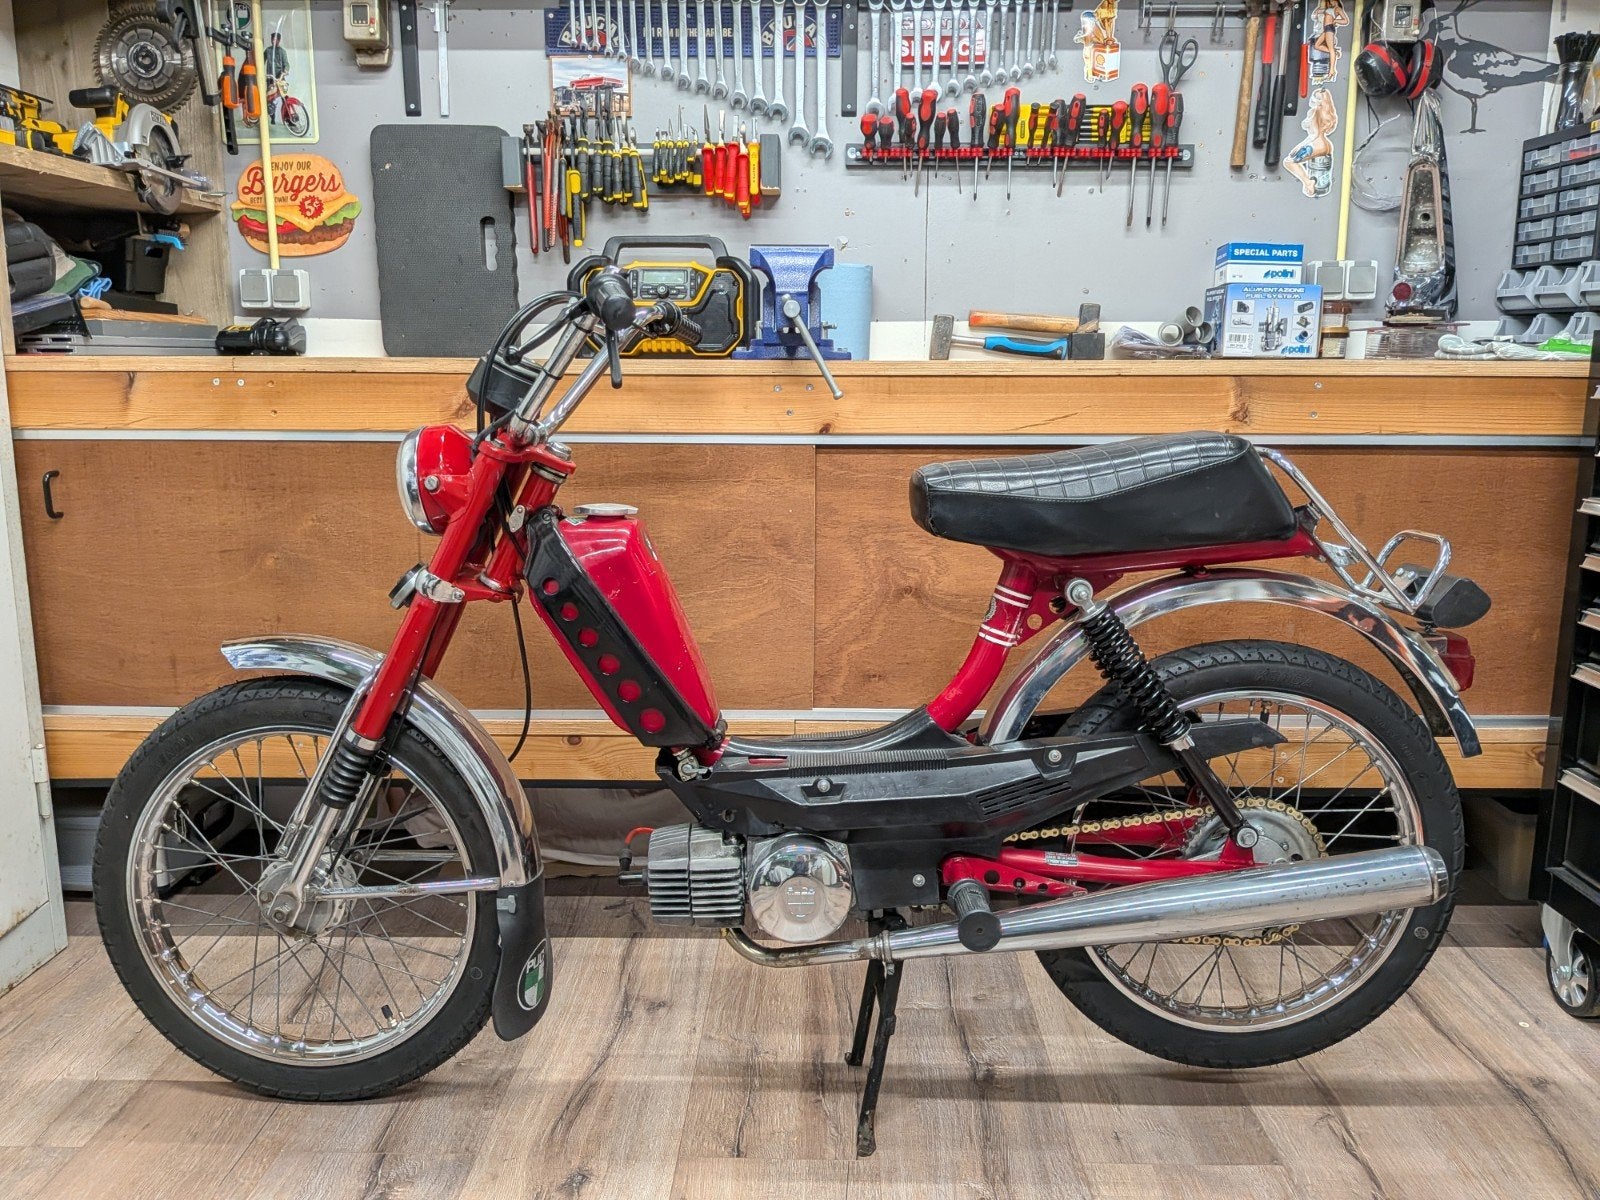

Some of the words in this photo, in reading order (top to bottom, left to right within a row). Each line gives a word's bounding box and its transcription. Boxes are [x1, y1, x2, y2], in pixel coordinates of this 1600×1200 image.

[900, 39, 985, 57] SRVCE
[271, 161, 294, 171] ENJOY
[296, 160, 312, 170] OUR
[1233, 248, 1270, 257] SPECIAL
[1271, 249, 1299, 257] PARTS
[1270, 269, 1295, 279] polini
[1287, 345, 1312, 356] polini
[526, 948, 545, 974] PUC
